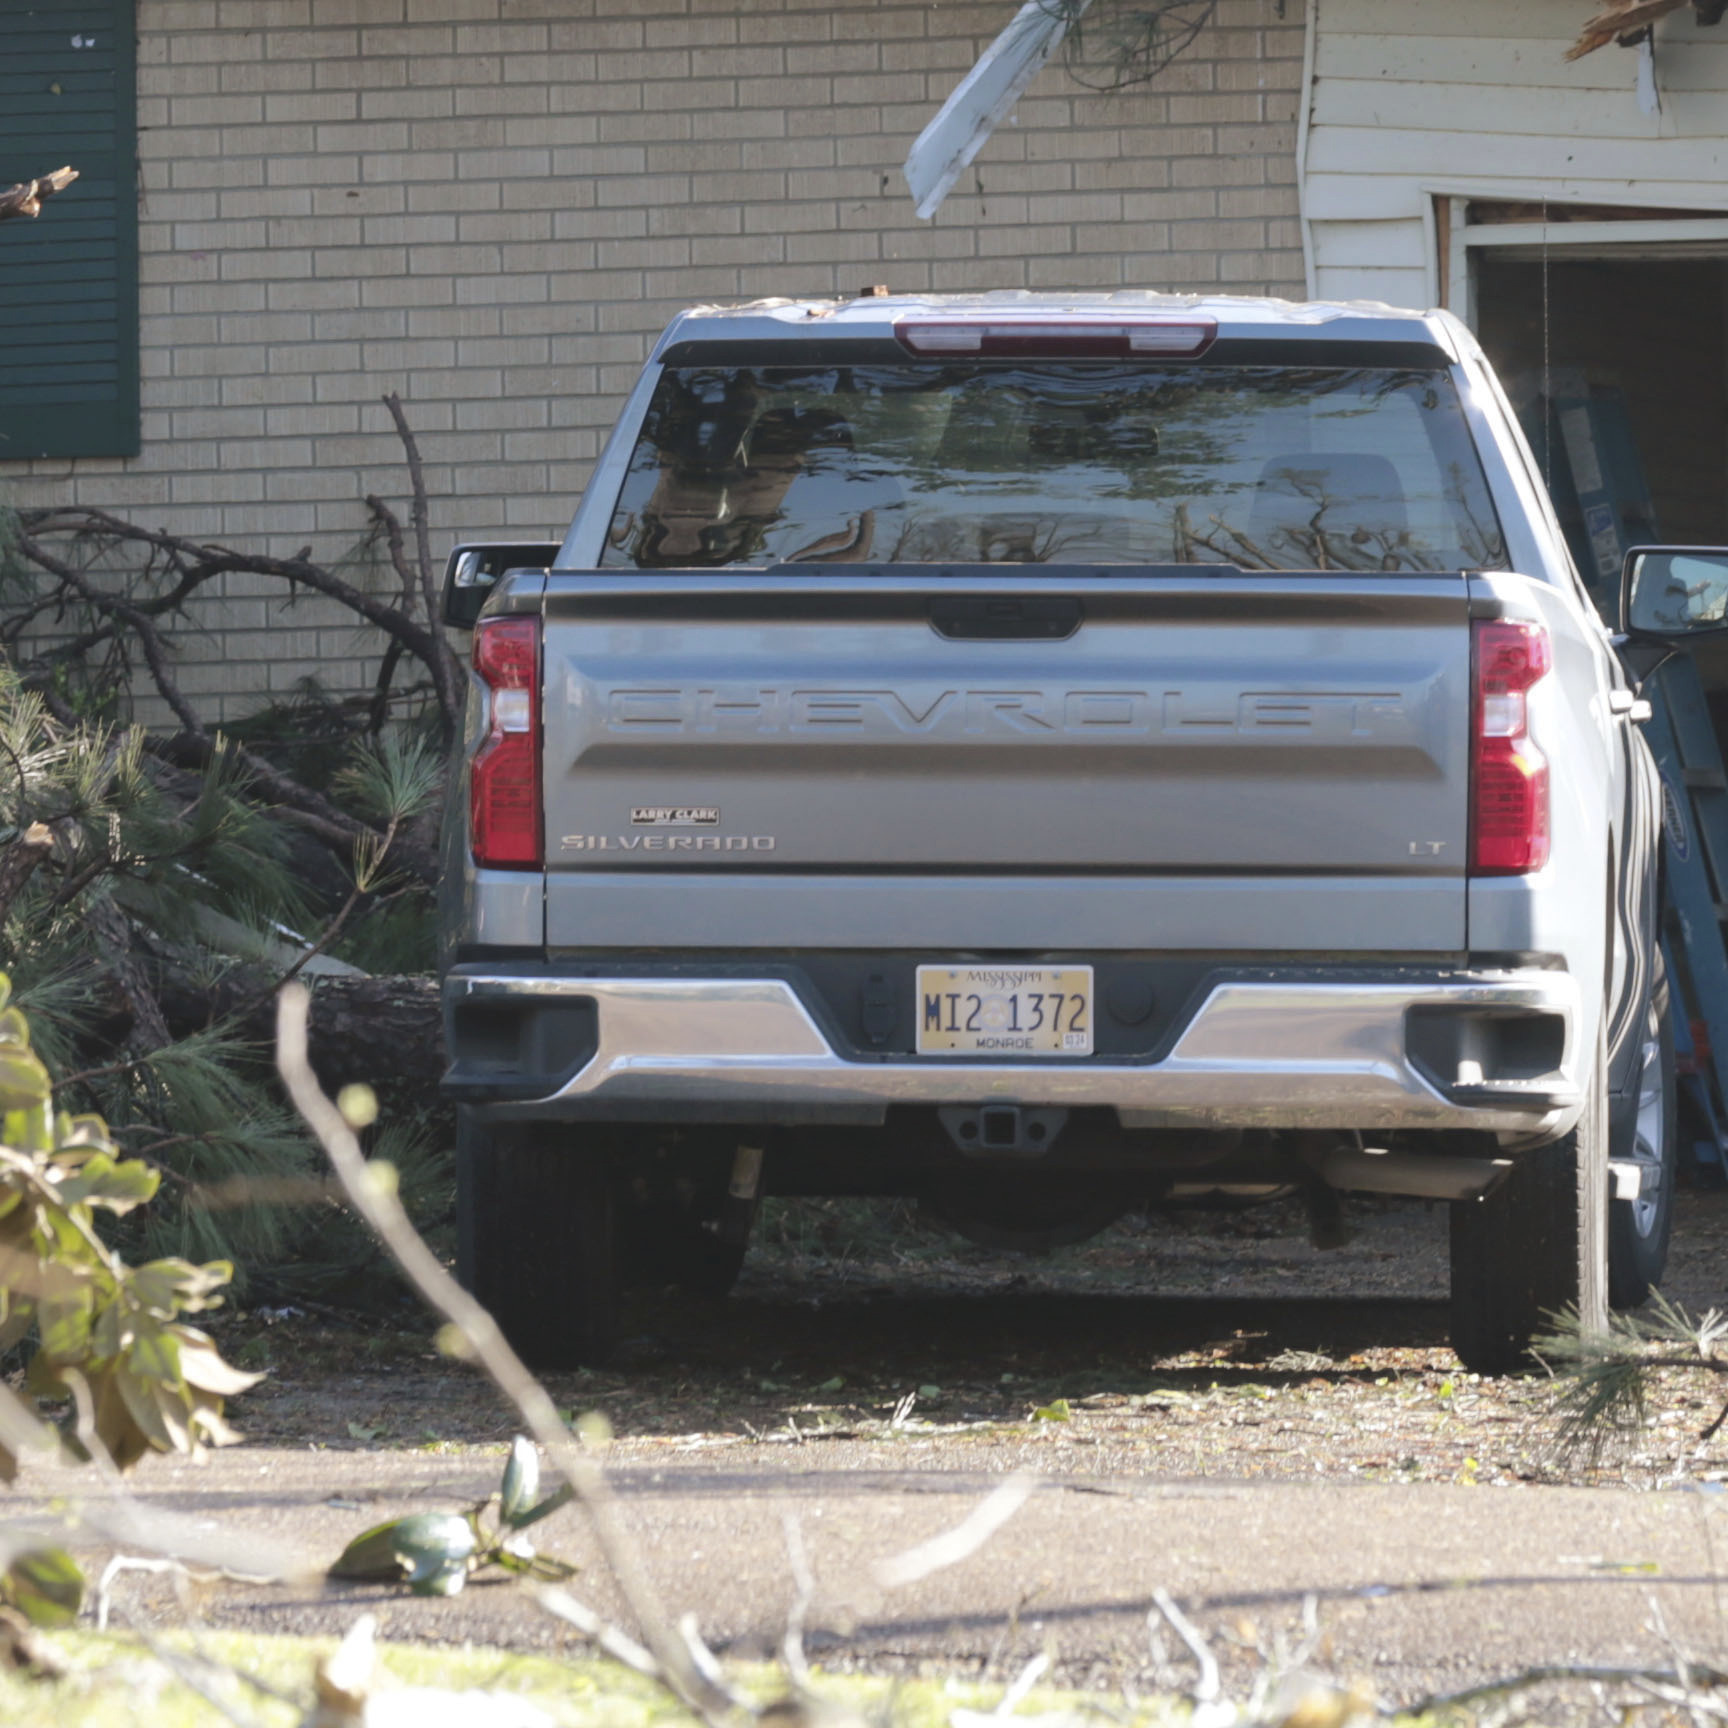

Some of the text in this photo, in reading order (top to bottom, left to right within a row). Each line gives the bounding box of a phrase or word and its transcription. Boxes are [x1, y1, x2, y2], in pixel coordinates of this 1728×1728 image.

[608, 689, 1402, 736] CHEVROLET
[632, 809, 717, 819] LARRY CLARK
[561, 834, 776, 851] SILVERADO
[1409, 841, 1447, 855] LT
[924, 993, 1086, 1032] MI2 1372
[976, 1037, 1034, 1049] MONROE
